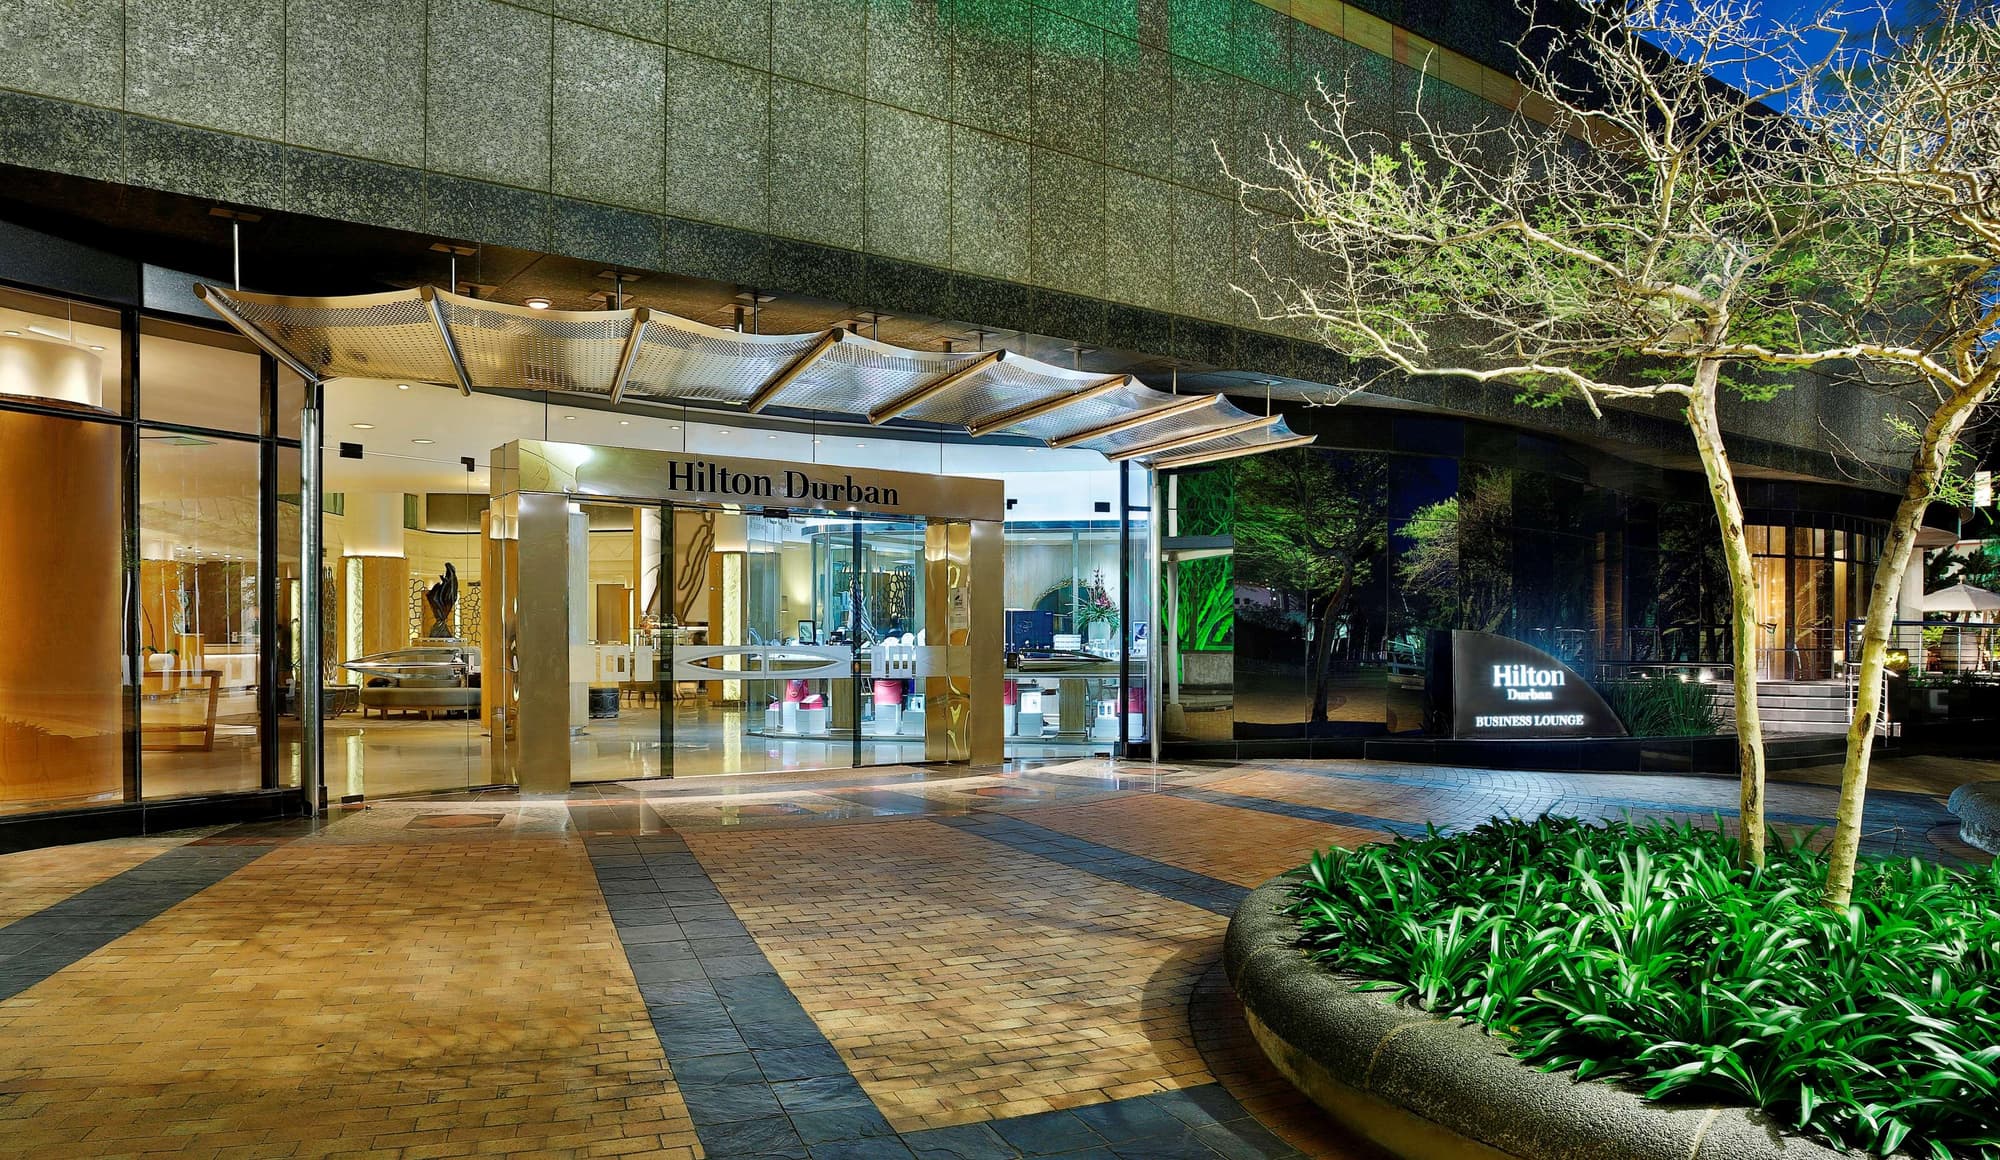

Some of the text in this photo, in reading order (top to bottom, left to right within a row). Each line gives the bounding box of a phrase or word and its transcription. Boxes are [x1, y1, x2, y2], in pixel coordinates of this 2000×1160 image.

[667, 460, 900, 506] Hilton Durban
[1493, 664, 1566, 687] Hilton
[1507, 688, 1553, 701] Durban
[1475, 714, 1584, 728] BUSINESS LOUNGE
